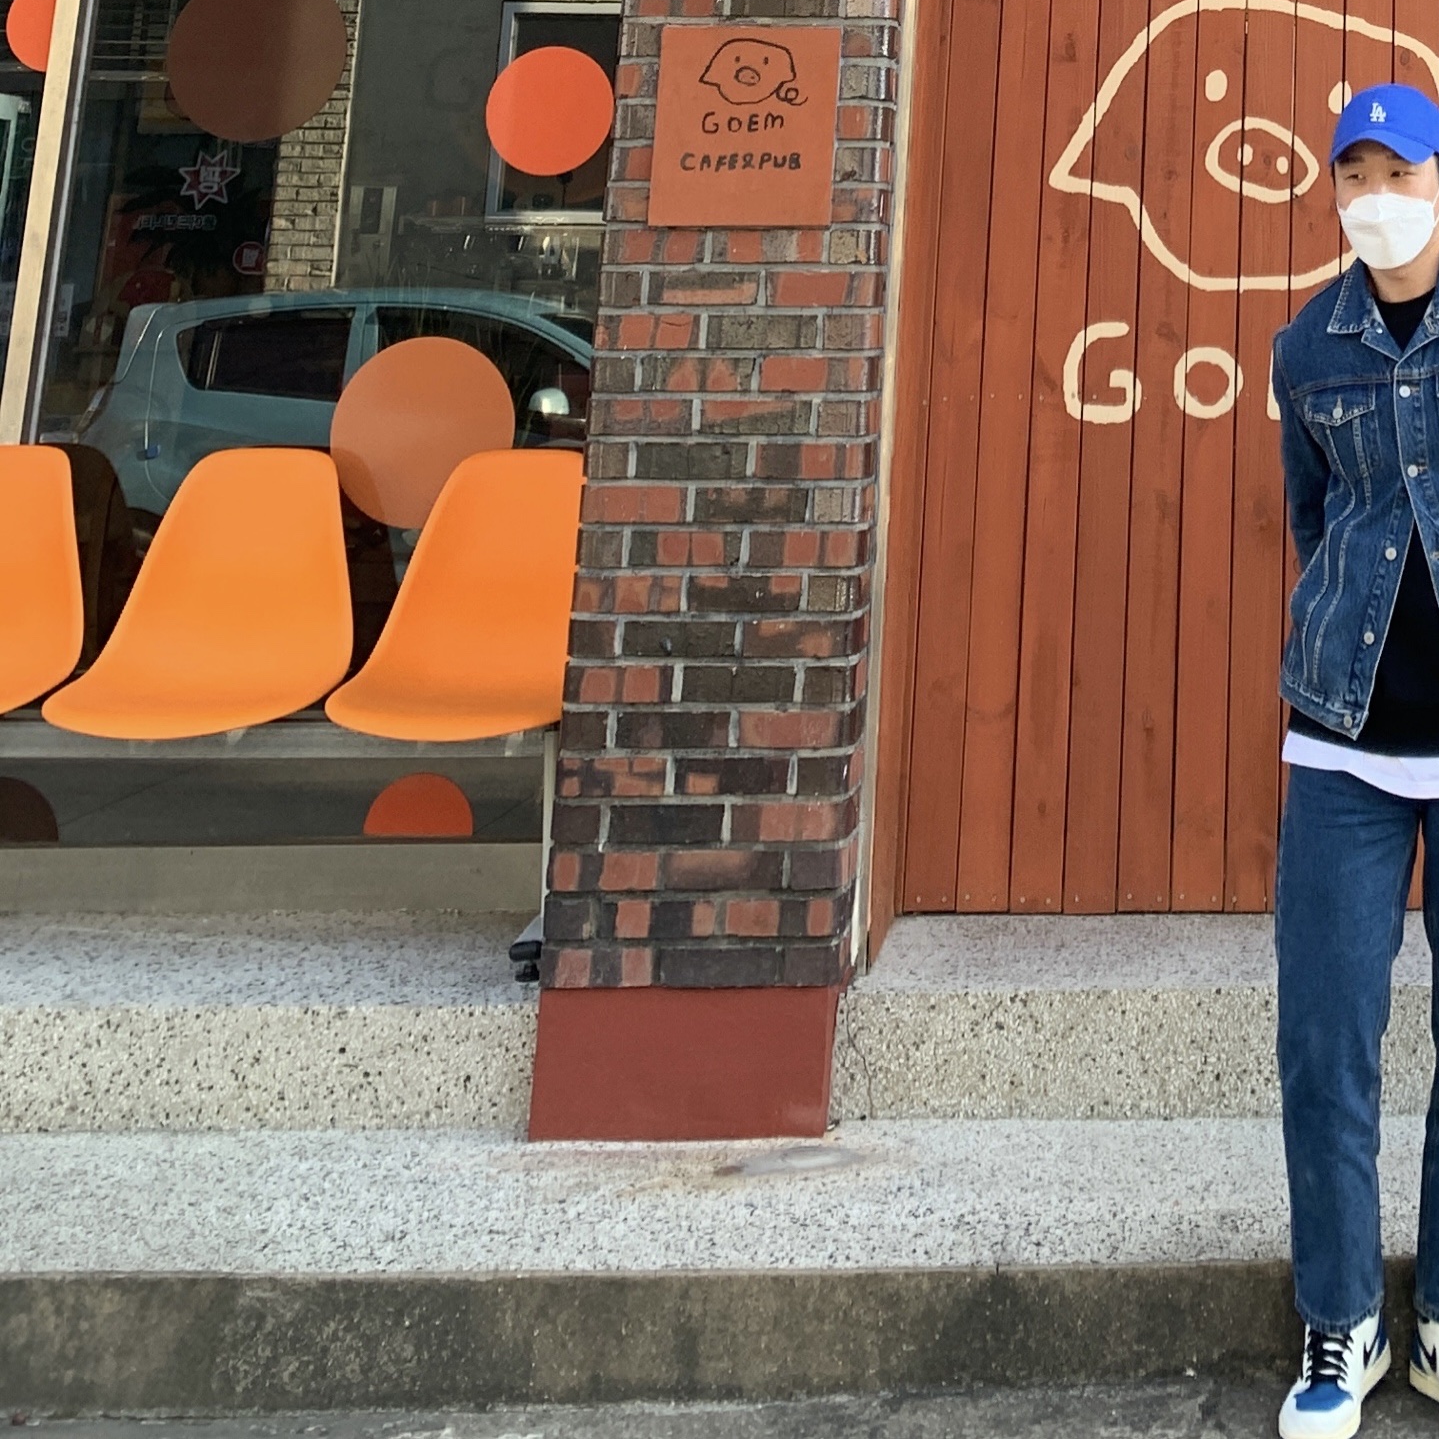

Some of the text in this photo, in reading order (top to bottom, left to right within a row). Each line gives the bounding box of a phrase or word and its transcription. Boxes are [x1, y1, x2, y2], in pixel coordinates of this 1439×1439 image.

[701, 112, 784, 134] GOEM
[1369, 102, 1387, 123] LA
[679, 152, 802, 173] CAFE&PUB
